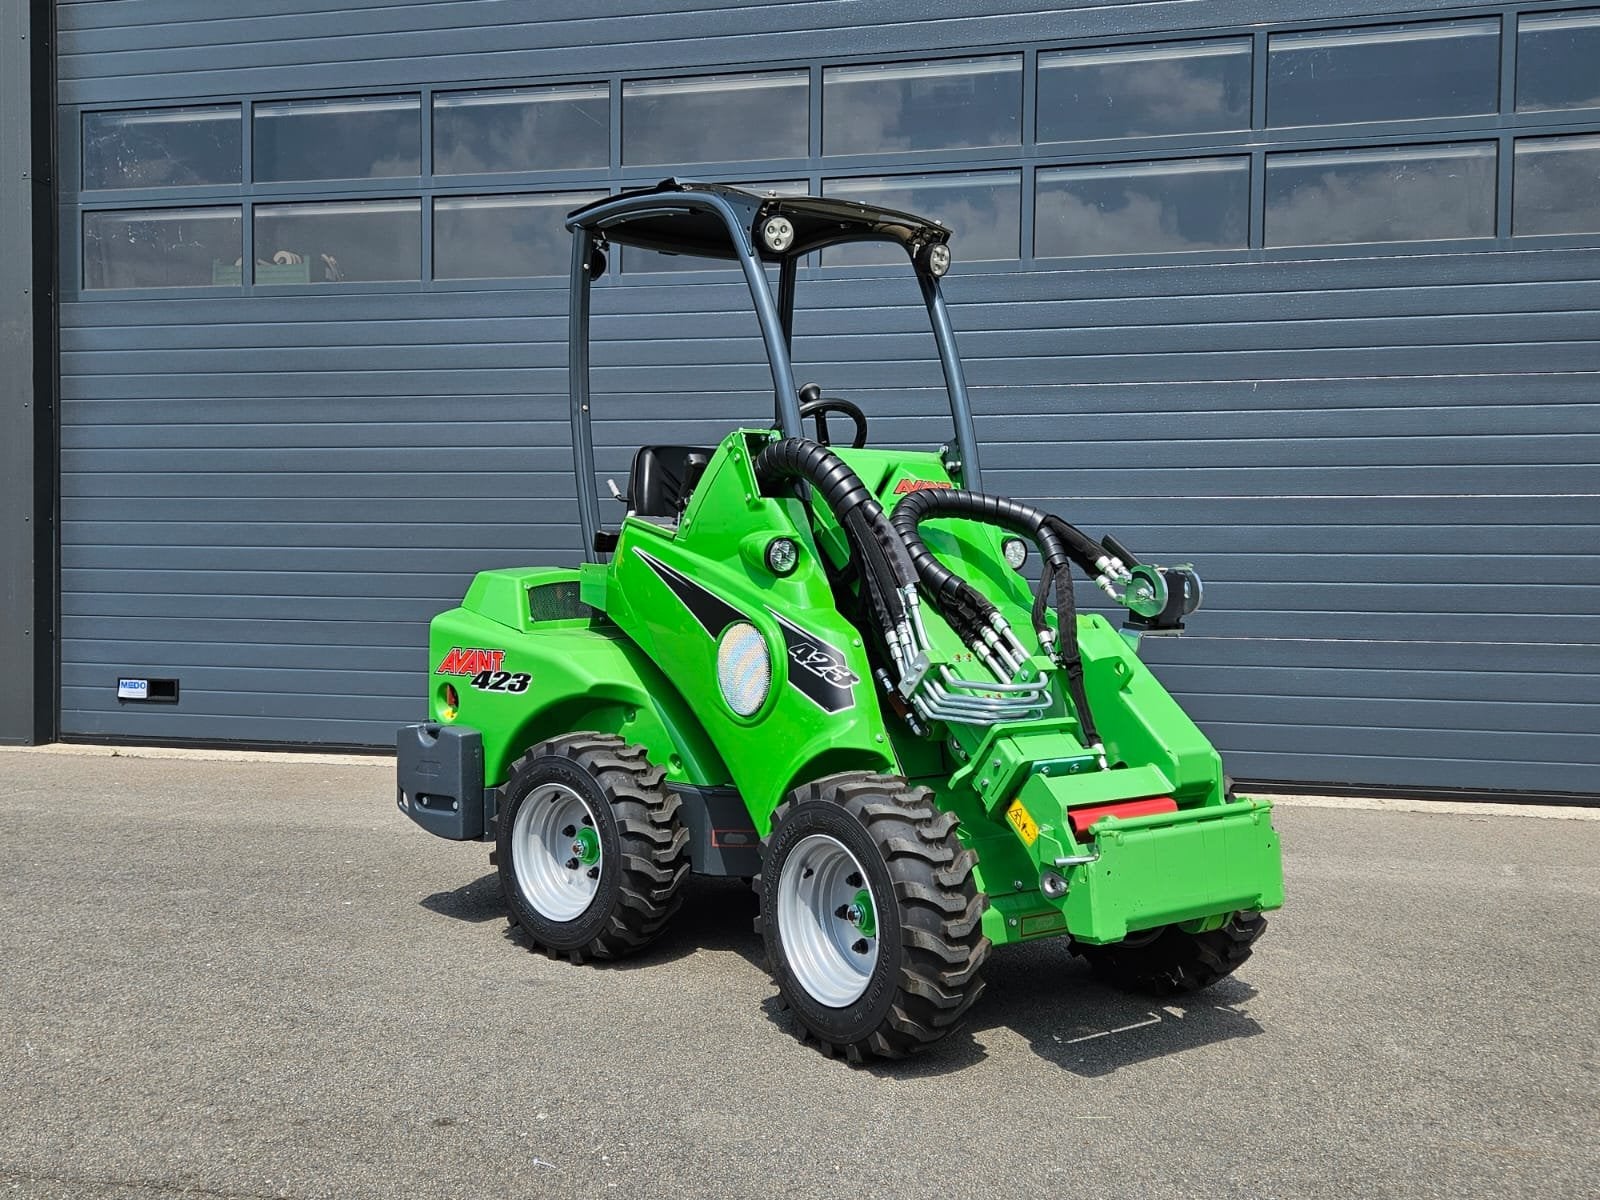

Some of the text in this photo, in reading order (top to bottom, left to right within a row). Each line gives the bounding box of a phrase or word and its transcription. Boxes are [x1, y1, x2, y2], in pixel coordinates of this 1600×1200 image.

[434, 647, 506, 676] AVANT
[788, 643, 860, 688] 423
[120, 681, 147, 690] MEDO
[470, 670, 533, 695] 423
